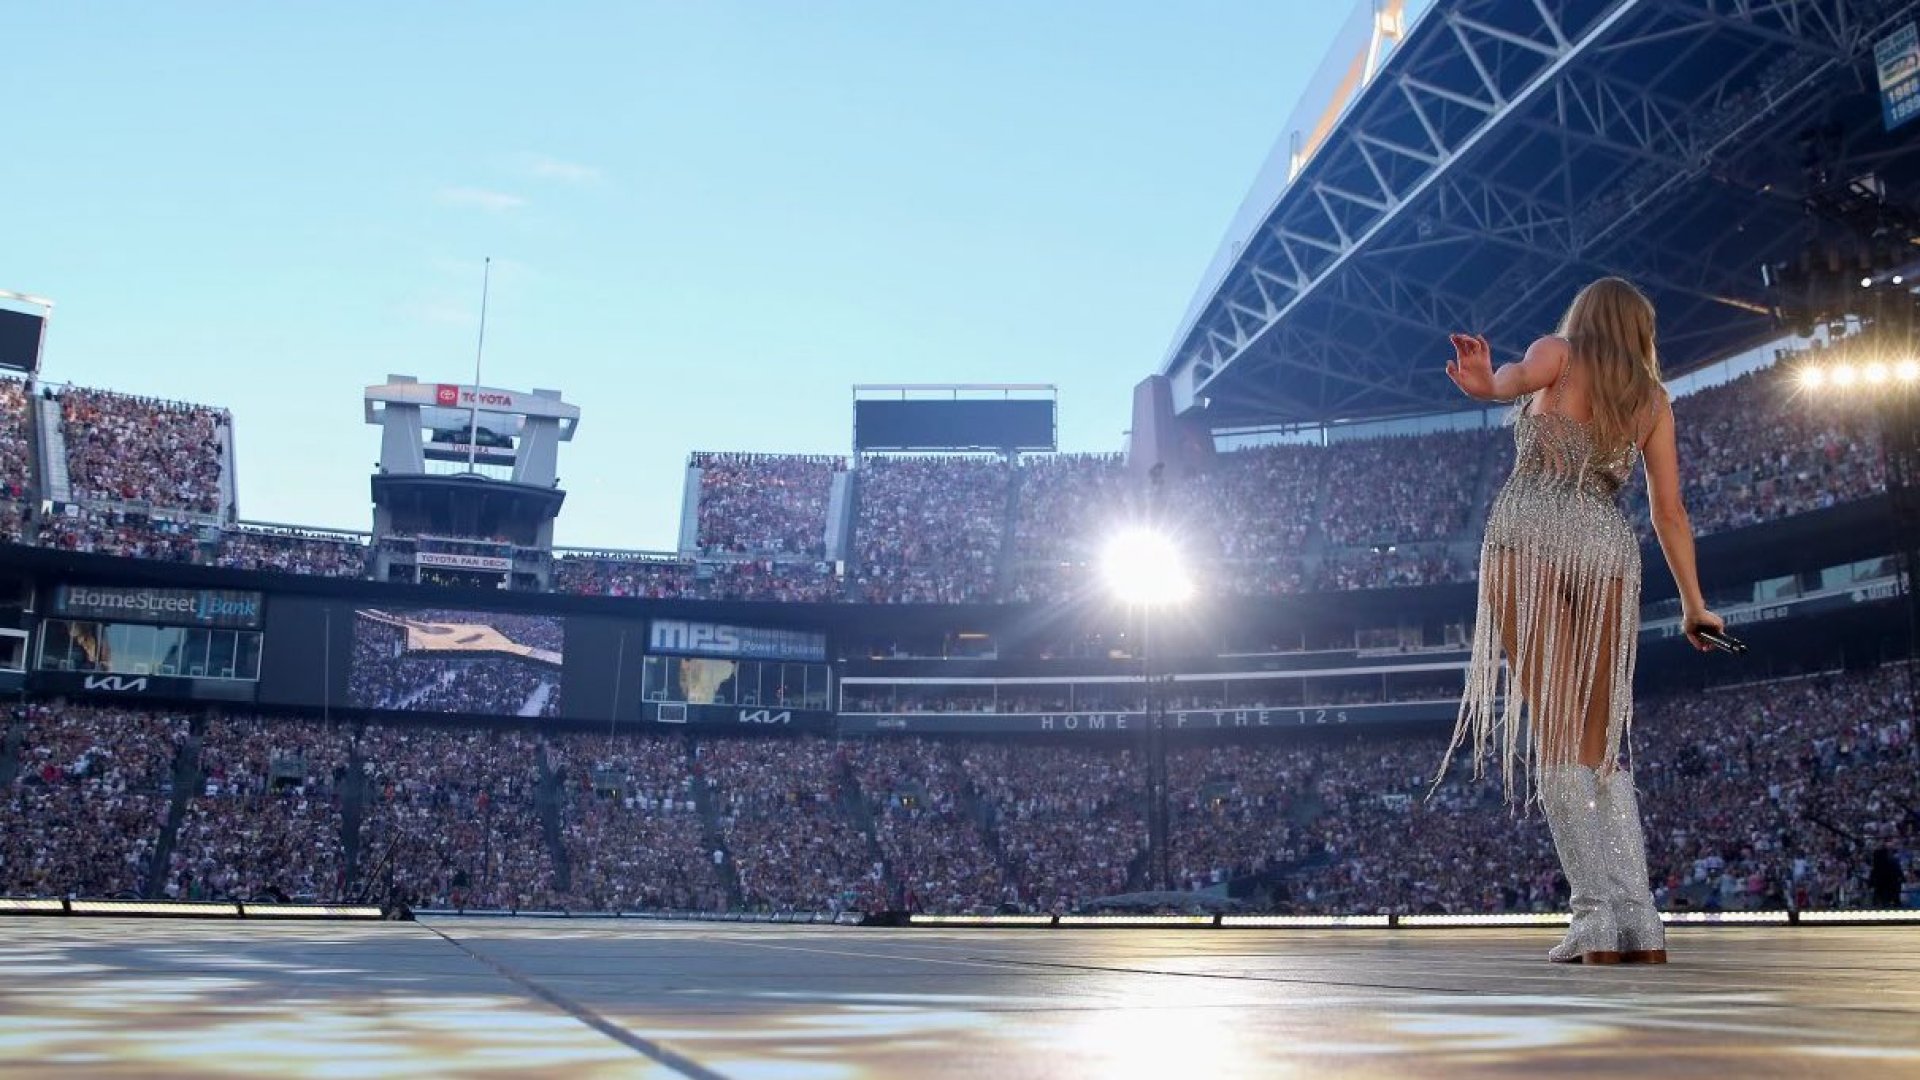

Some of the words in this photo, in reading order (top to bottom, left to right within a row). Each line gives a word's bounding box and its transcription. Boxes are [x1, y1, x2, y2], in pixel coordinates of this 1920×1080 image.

[462, 392, 512, 406] TOYOTA
[422, 554, 457, 564] TOYOTA
[460, 557, 479, 566] FAN
[483, 559, 507, 567] DECK
[69, 588, 197, 612] HomeStreet
[209, 597, 256, 616] Bank
[652, 620, 740, 651] MPS
[743, 640, 778, 653] Power
[1041, 714, 1127, 729] HOME
[1212, 710, 1270, 727] THE
[1297, 709, 1347, 724] 12s
